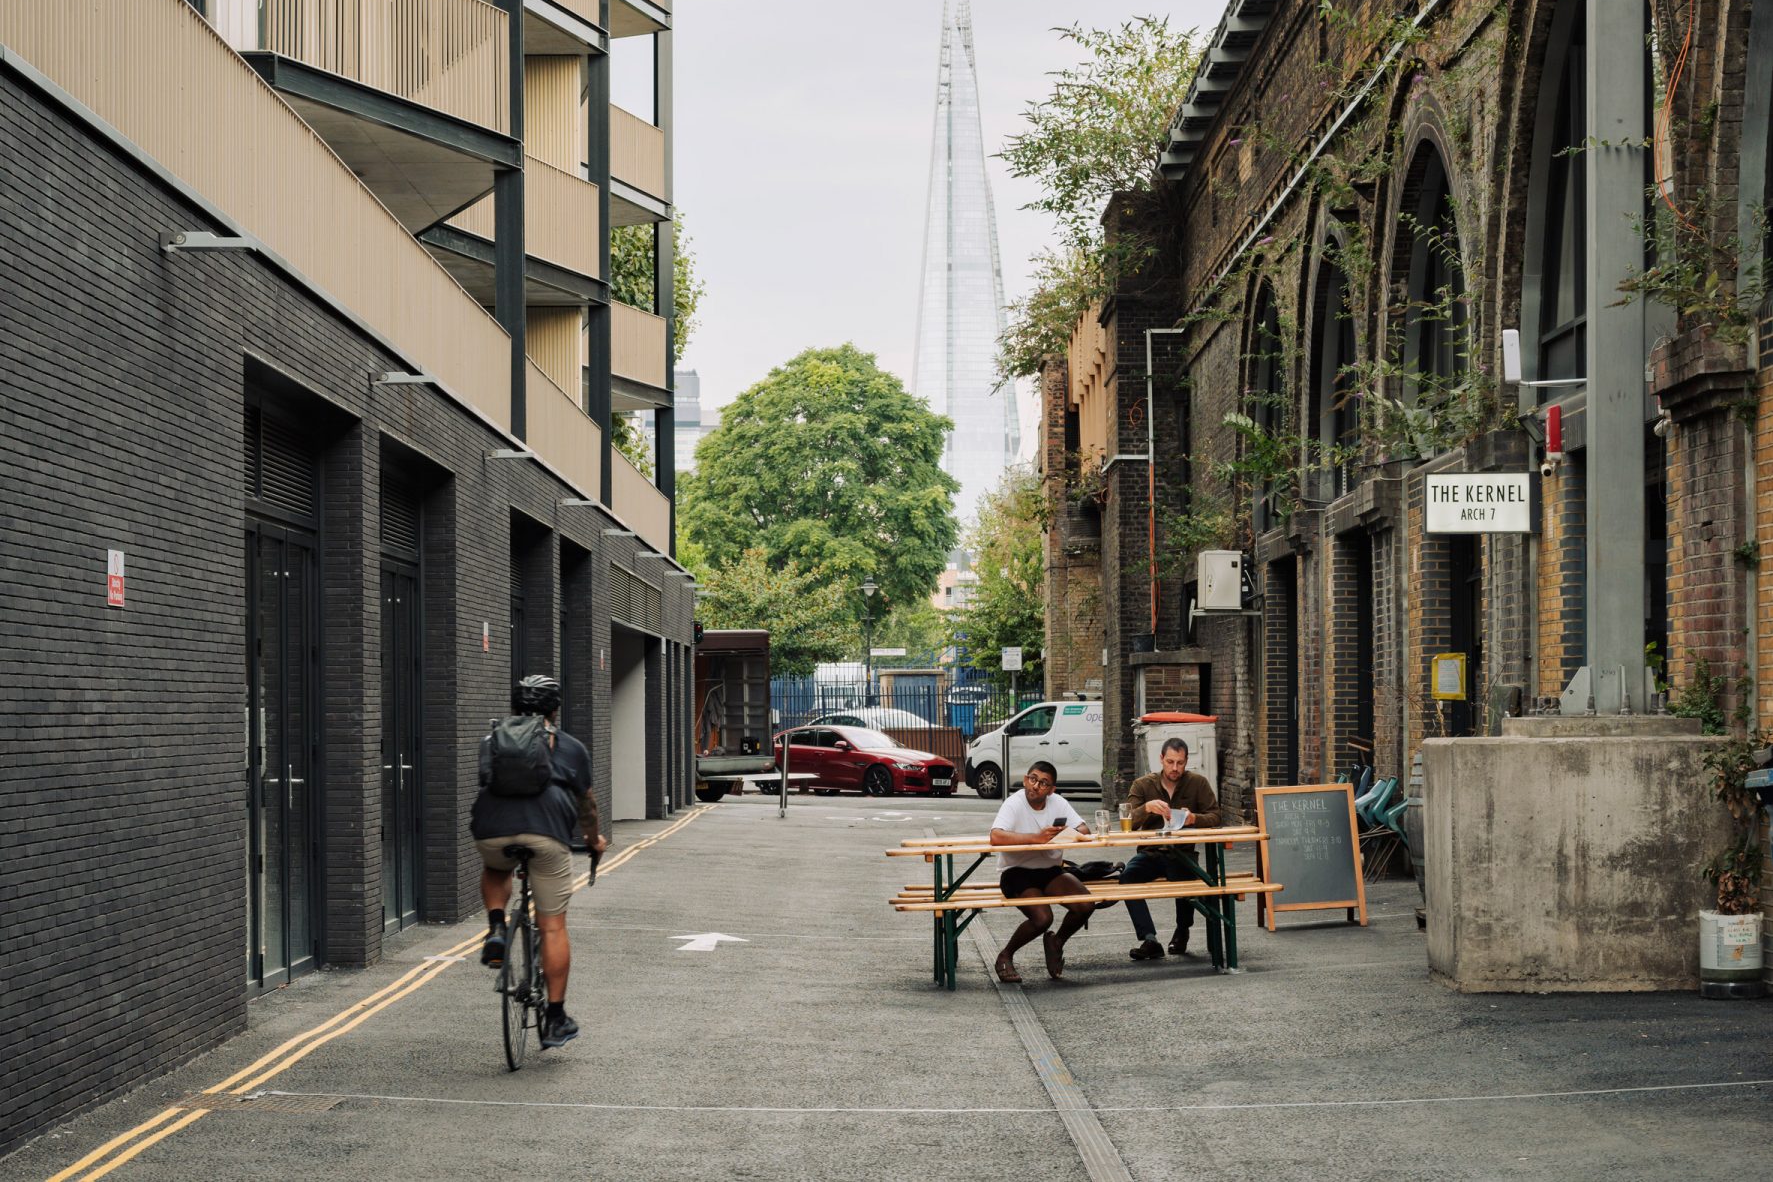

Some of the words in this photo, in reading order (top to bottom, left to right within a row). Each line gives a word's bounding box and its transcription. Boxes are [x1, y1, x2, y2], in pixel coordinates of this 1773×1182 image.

[1431, 485, 1459, 503] THE
[1466, 484, 1525, 503] KERNEL
[1460, 508, 1485, 521] ARCH
[1490, 508, 1496, 521] 7
[1271, 800, 1289, 811] THE
[1291, 798, 1328, 811] KERNEL
